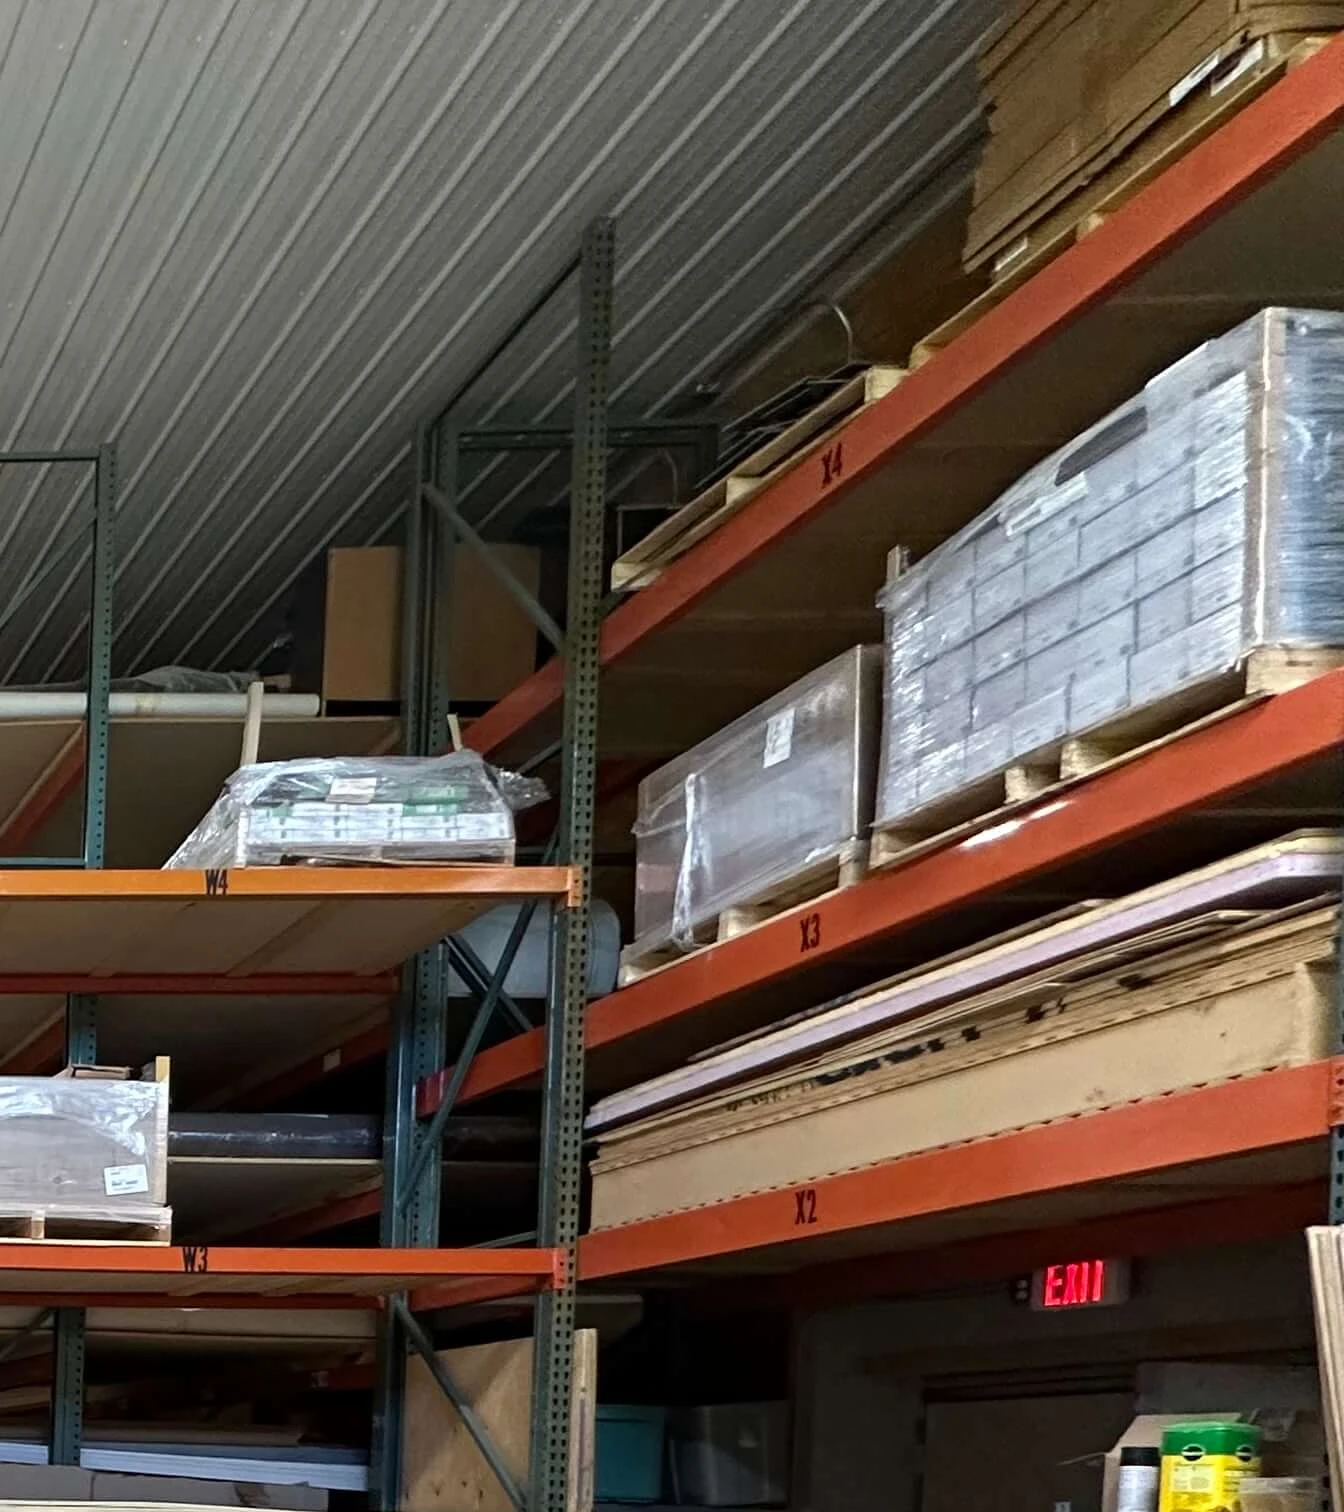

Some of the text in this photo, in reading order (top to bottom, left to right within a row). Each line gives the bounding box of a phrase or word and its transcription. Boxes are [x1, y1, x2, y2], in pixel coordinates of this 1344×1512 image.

[822, 442, 843, 489] X4
[205, 869, 228, 896] W4
[800, 913, 820, 952] X3
[795, 1190, 817, 1224] X2
[182, 1246, 208, 1272] W3
[1044, 1260, 1104, 1306] EXIT
